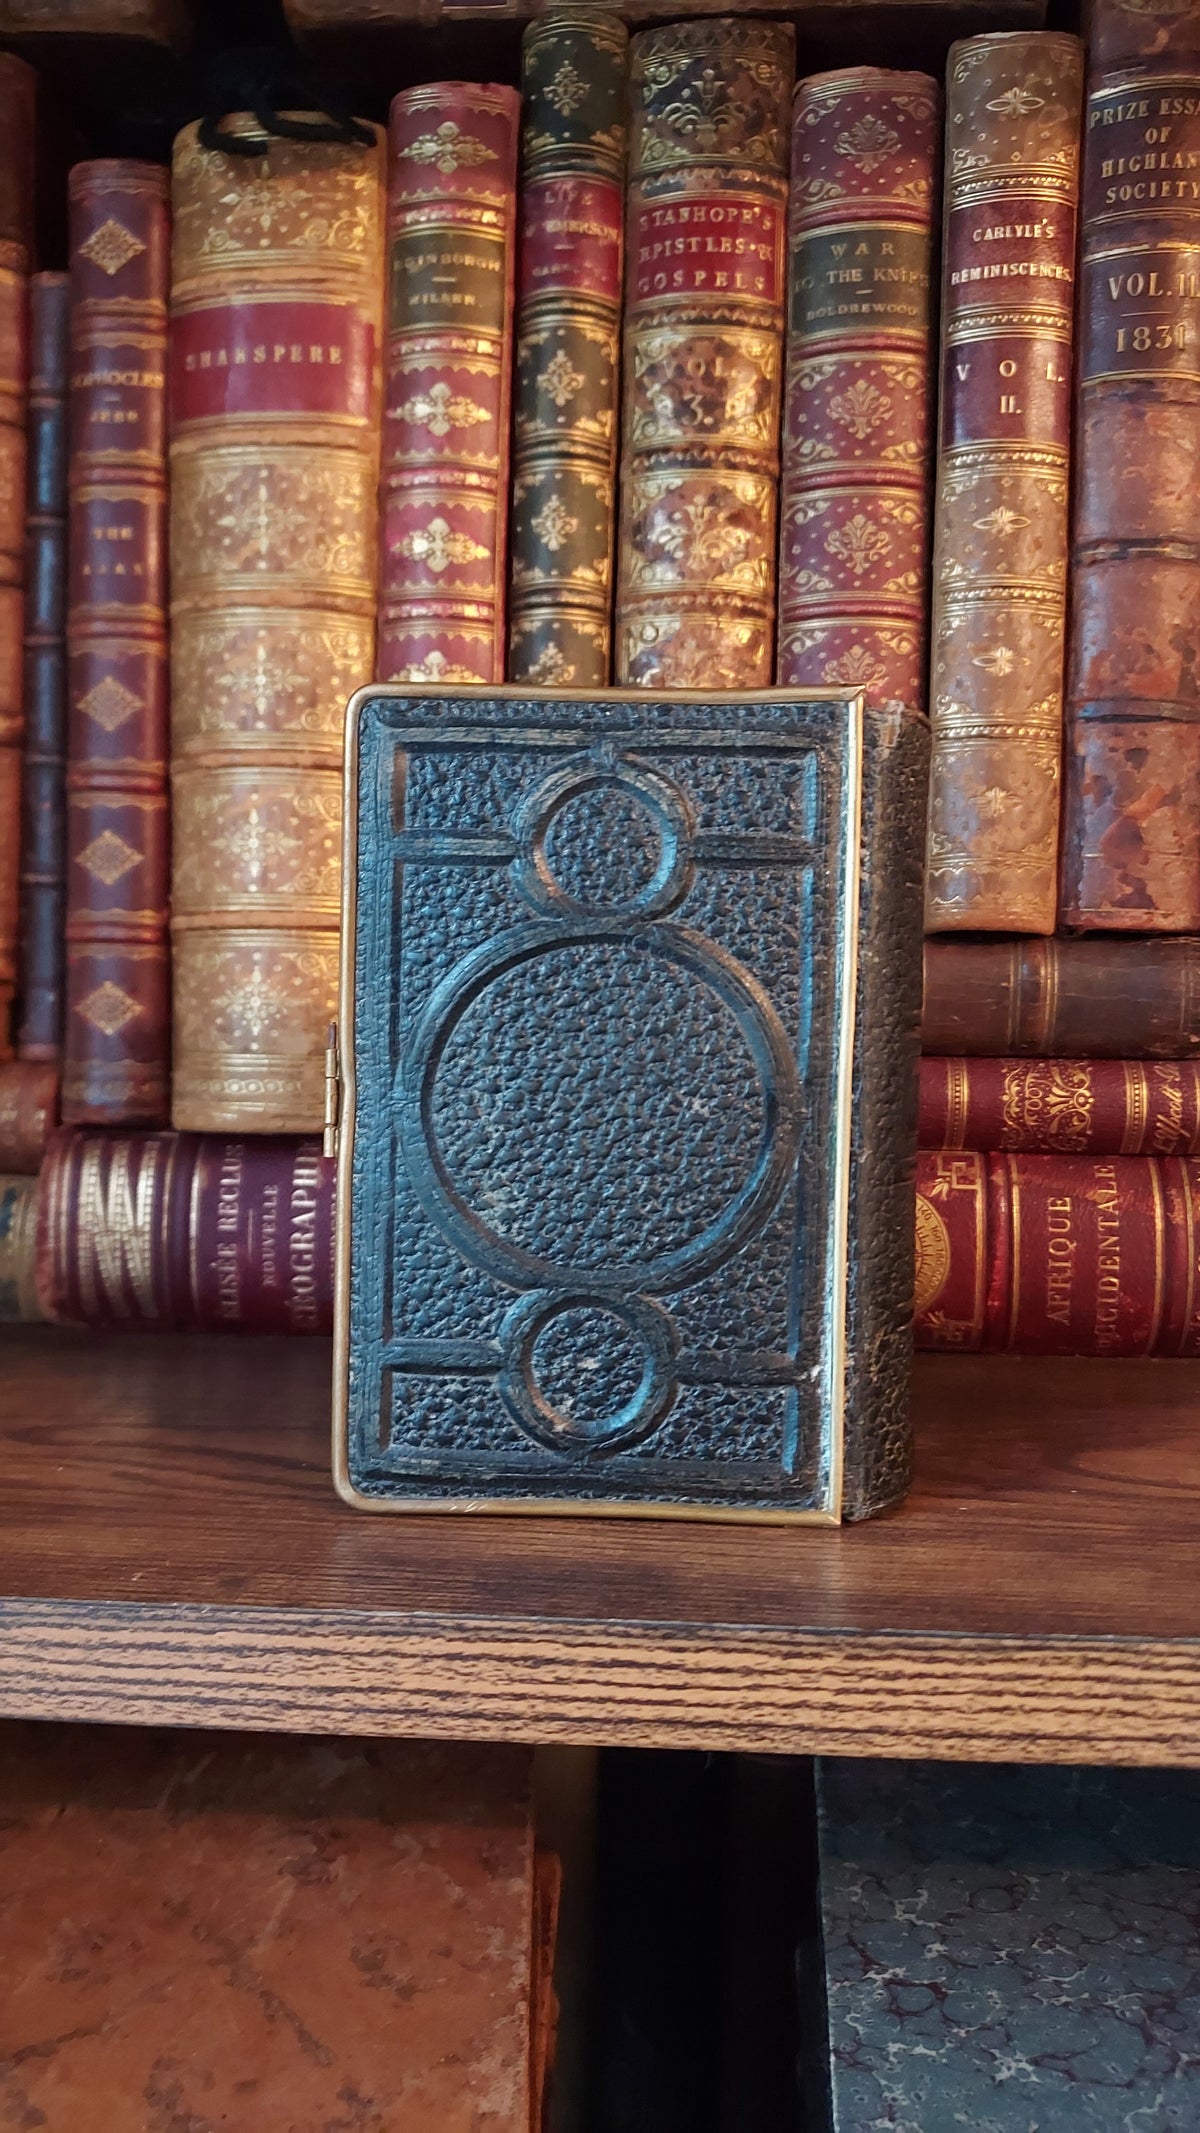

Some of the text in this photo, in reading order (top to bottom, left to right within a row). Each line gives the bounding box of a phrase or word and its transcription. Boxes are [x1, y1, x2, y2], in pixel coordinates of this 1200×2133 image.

[1090, 100, 1150, 130] PRIZE
[1144, 126, 1173, 145] OF
[1105, 180, 1200, 204] SOCIETY
[639, 206, 774, 232] STANHOPE'S
[972, 218, 1055, 242] CARLYLE'S
[830, 242, 896, 259] WAR
[638, 269, 766, 293] GOSPELS
[826, 267, 864, 284] THE
[262, 1184, 278, 1287] NOUVELLE
[1047, 1196, 1077, 1327] AFRIQUE
